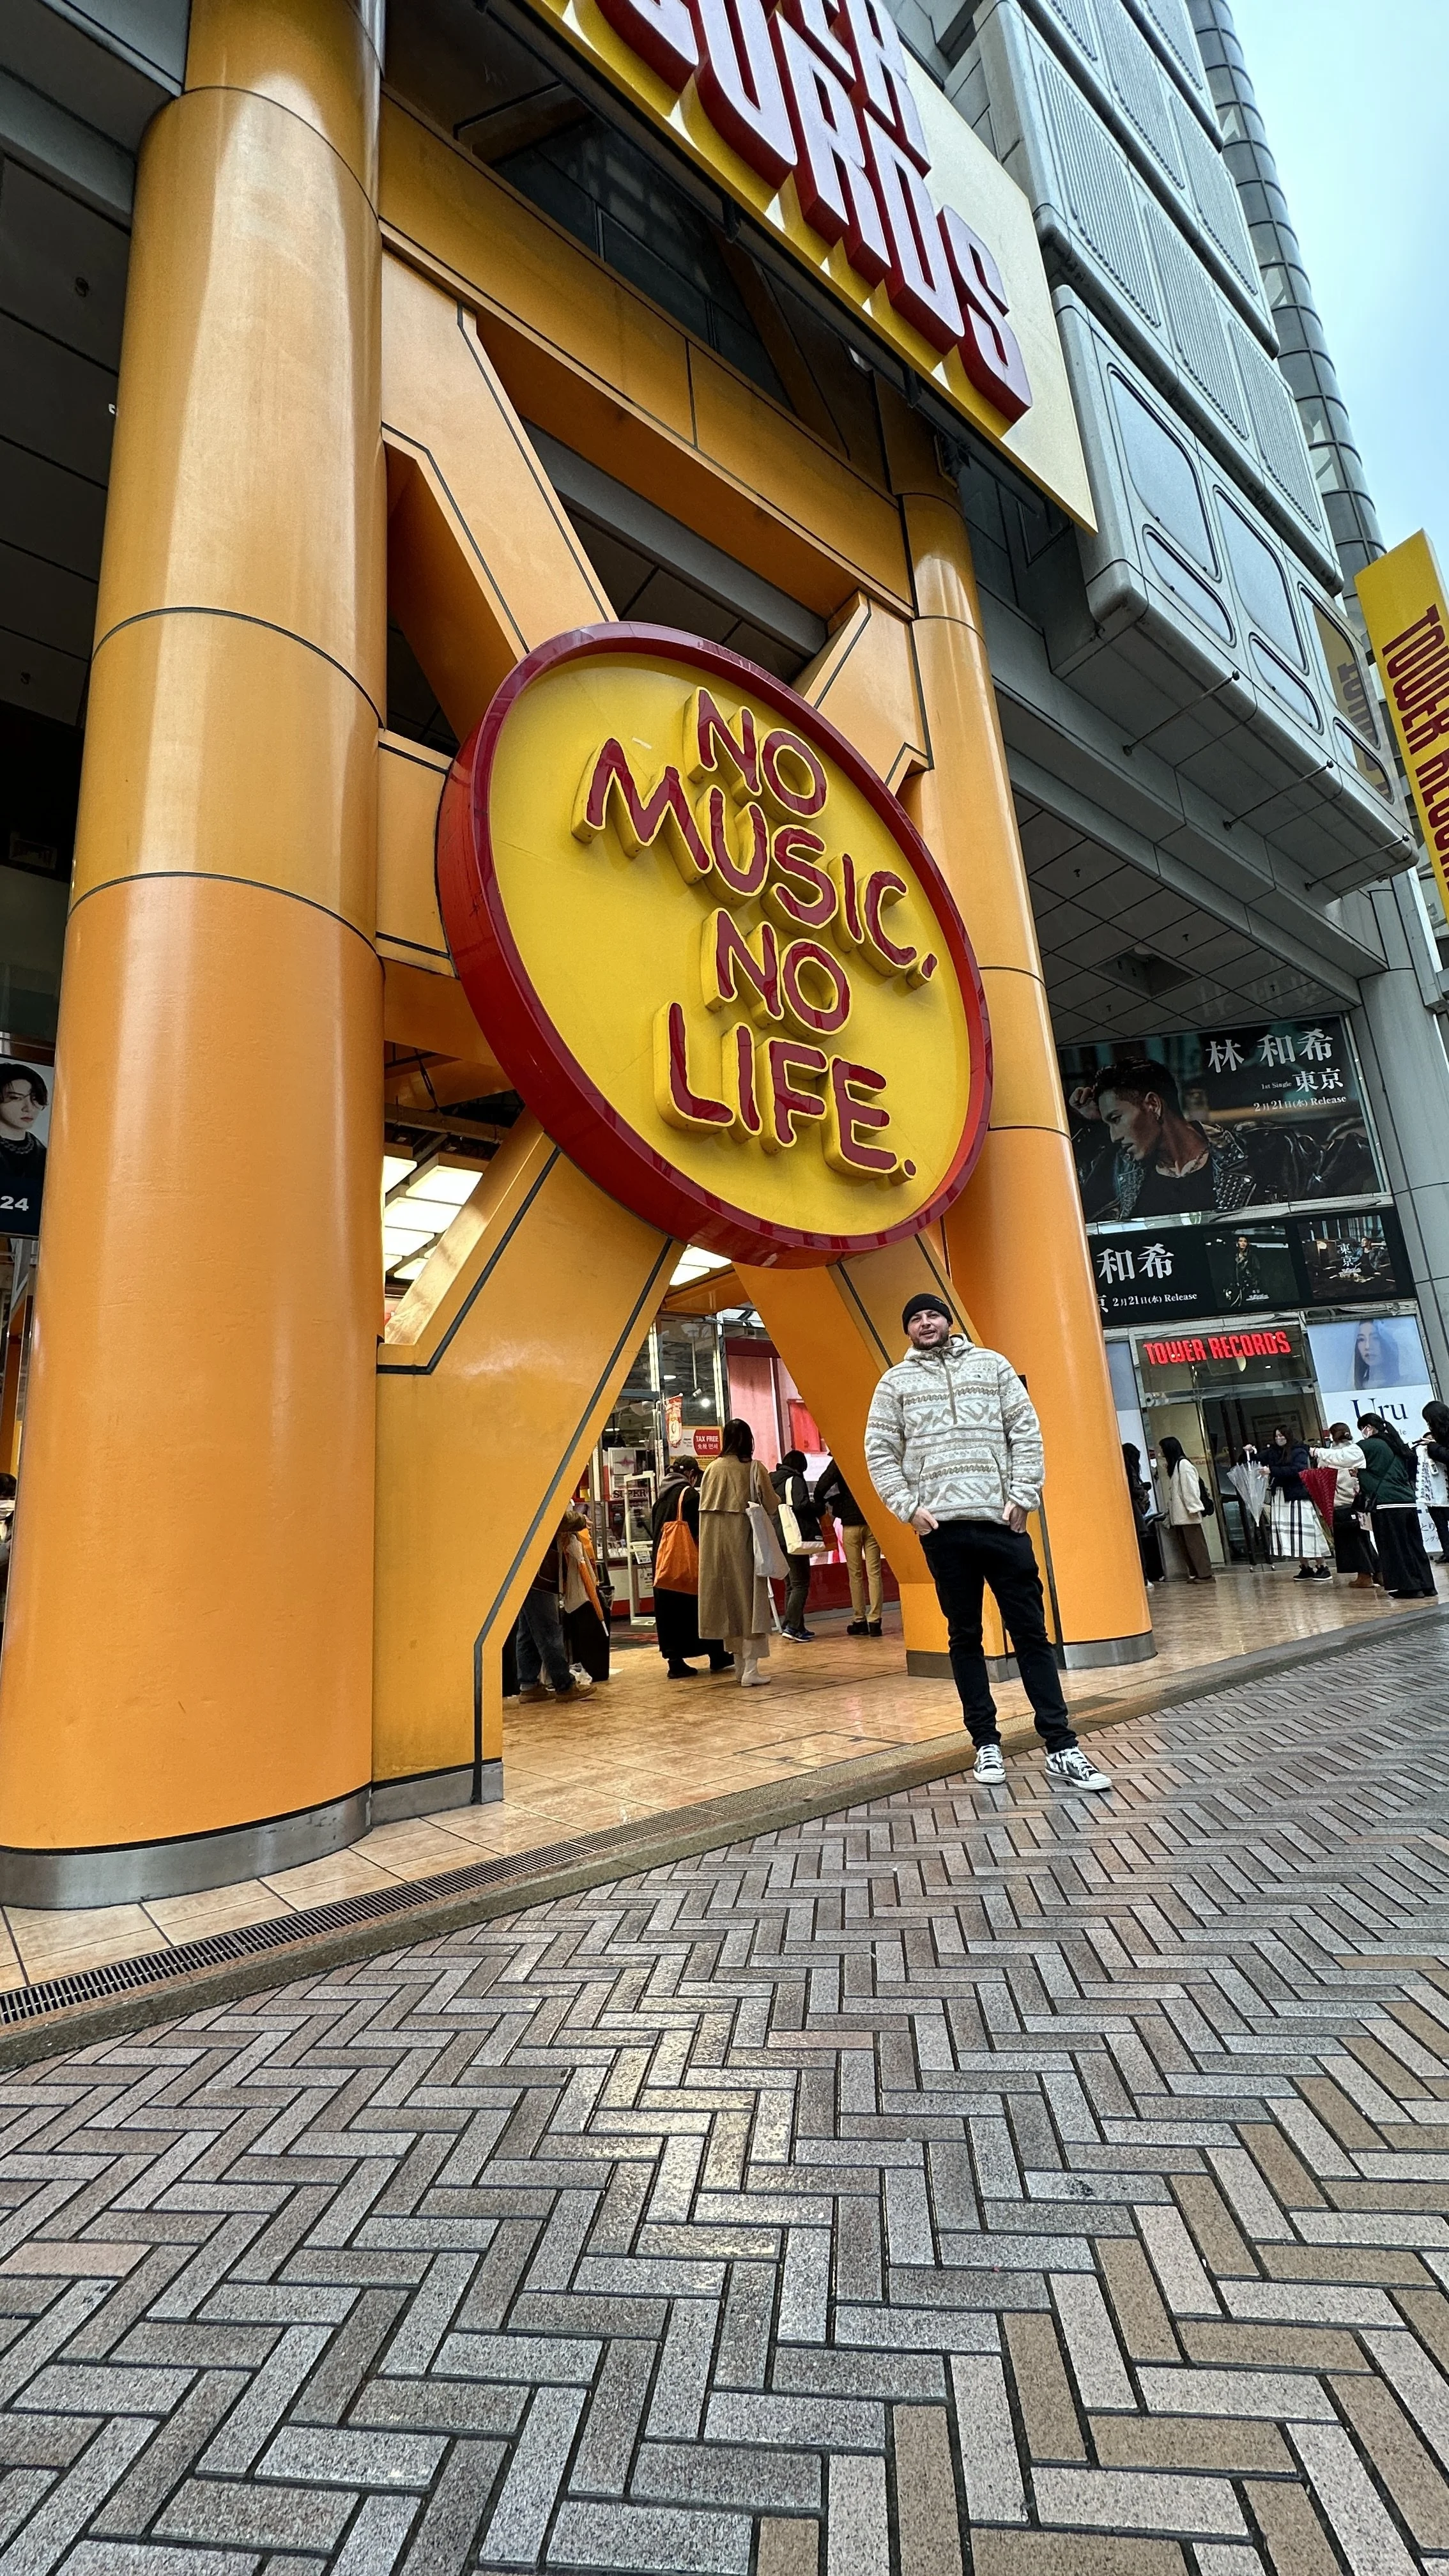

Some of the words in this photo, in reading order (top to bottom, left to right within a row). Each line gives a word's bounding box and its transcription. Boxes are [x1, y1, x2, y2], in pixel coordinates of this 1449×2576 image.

[687, 686, 829, 820] NO
[708, 908, 852, 1034] NO
[1205, 1039, 1245, 1073] 林
[1257, 1028, 1333, 1068] 和希
[659, 1002, 917, 1183] LIFE.
[1292, 1068, 1344, 1092] 東京
[1310, 1096, 1347, 1106] Release
[1096, 1243, 1174, 1284] 和希
[1164, 1293, 1197, 1303] Release
[1143, 1338, 1207, 1365] TOWER
[1207, 1331, 1292, 1360] RECORDS
[1351, 1398, 1409, 1420] Uru
